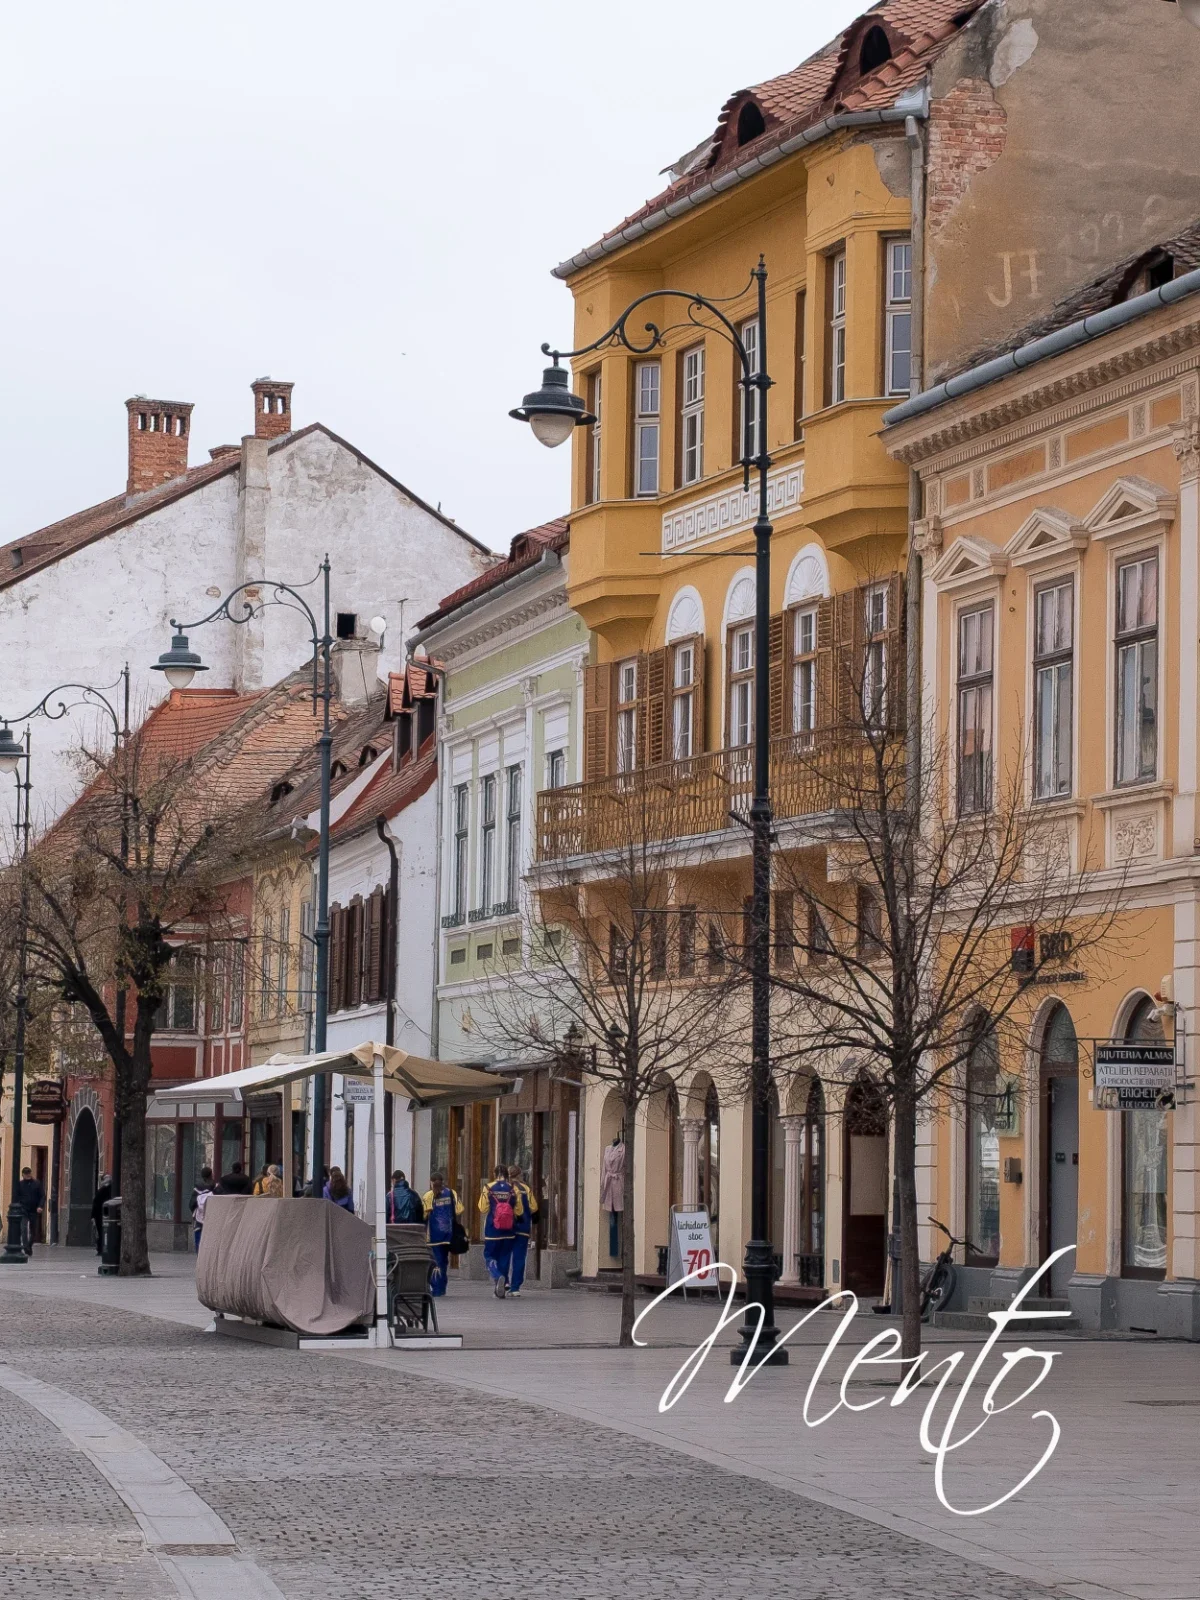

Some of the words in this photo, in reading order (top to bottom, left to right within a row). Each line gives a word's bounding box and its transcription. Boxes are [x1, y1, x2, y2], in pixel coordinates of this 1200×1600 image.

[1097, 1050, 1142, 1061] BIJUTERIA
[1143, 1051, 1173, 1060] ALMAS
[1099, 1065, 1133, 1076] ATELIER
[677, 1220, 710, 1230] lichidare
[688, 1233, 704, 1241] stoc
